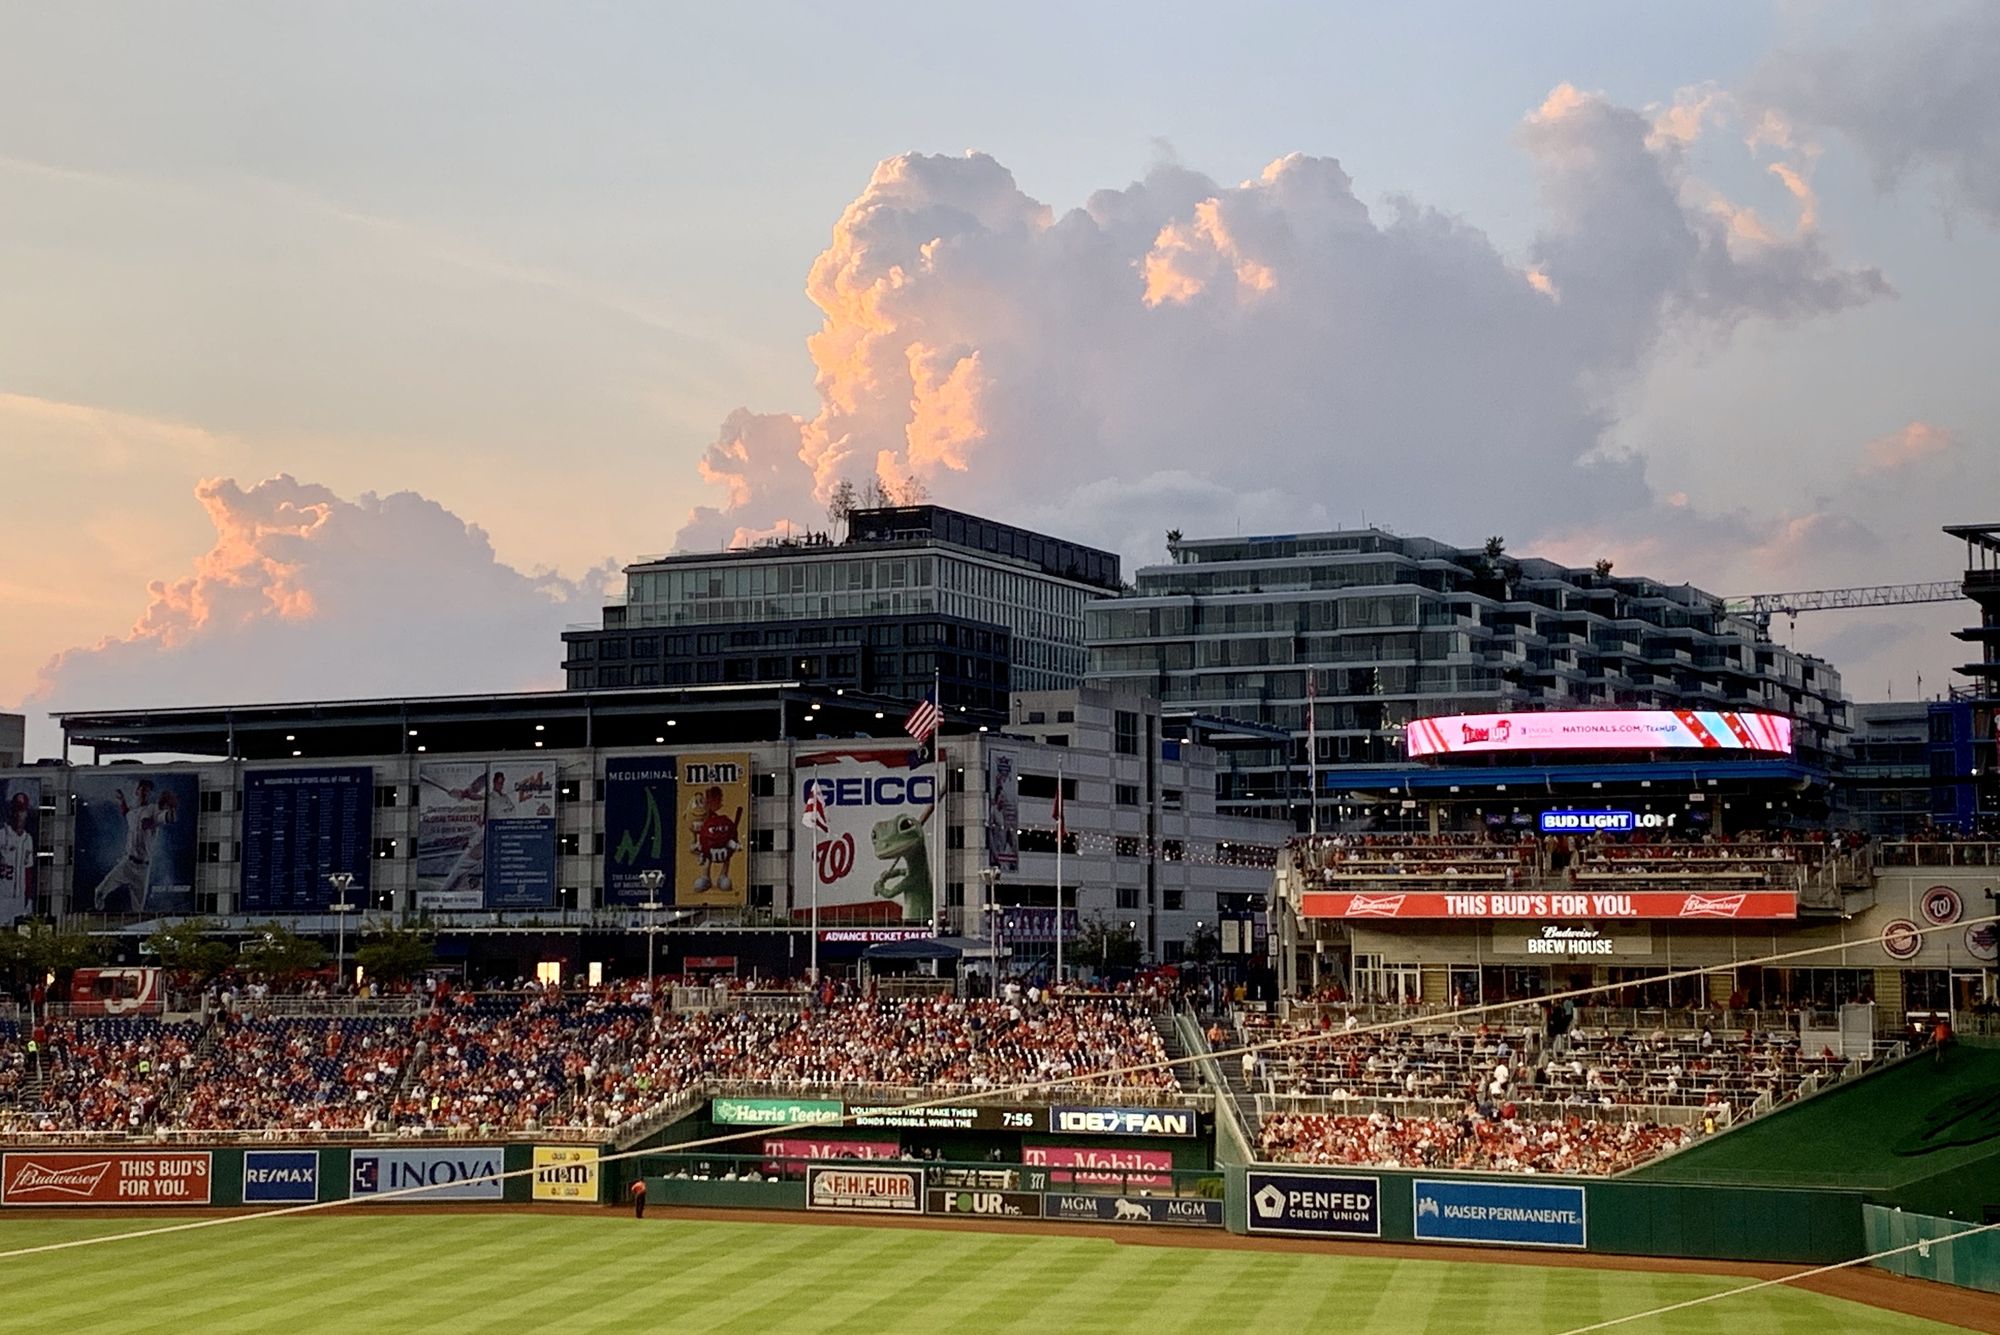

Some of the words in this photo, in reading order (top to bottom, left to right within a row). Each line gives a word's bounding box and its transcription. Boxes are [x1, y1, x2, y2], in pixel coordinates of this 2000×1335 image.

[803, 776, 935, 806] GEICO
[1544, 815, 1579, 828] BUD
[1580, 815, 1629, 828] LIGHT
[1350, 900, 1398, 912] Budweiser
[1444, 895, 1486, 916] THIS
[1491, 895, 1547, 916] BUD'S
[1551, 895, 1588, 916] FOR
[1591, 895, 1637, 916] YOU.
[1688, 900, 1739, 912] Budweiser
[825, 931, 868, 942] ADVANCE
[869, 931, 902, 941] TICKET
[1541, 926, 1598, 938] Budweiser
[1528, 940, 1565, 954] BREW
[1568, 940, 1613, 954] HOUSE
[737, 1104, 786, 1122] Harris
[791, 1107, 839, 1125] Teeter
[926, 1108, 950, 1117] MAKE
[951, 1109, 978, 1118] THESE
[1003, 1112, 1034, 1128] 7:56
[856, 1117, 885, 1126] BONDS
[928, 1119, 954, 1128] WHEN
[955, 1119, 972, 1128] THE
[1125, 1114, 1187, 1133] FAN
[119, 1160, 155, 1176] THIS
[159, 1160, 206, 1177] BUD'S
[247, 1168, 313, 1183] RE/MAX
[390, 1160, 499, 1188] INOVA
[18, 1168, 99, 1187] Budweiser
[1030, 1172, 1046, 1190] 377
[118, 1180, 149, 1196] FOR
[153, 1180, 190, 1196] YOU.
[944, 1191, 1004, 1213] FOUR
[1060, 1197, 1098, 1212] MGM
[1289, 1190, 1370, 1210] PENFED
[1167, 1201, 1206, 1216] MGM
[1289, 1210, 1329, 1221] CREDIT
[1333, 1211, 1369, 1222] UNION
[1444, 1205, 1487, 1221] KAISER
[1489, 1207, 1577, 1225] PERMANENTE
